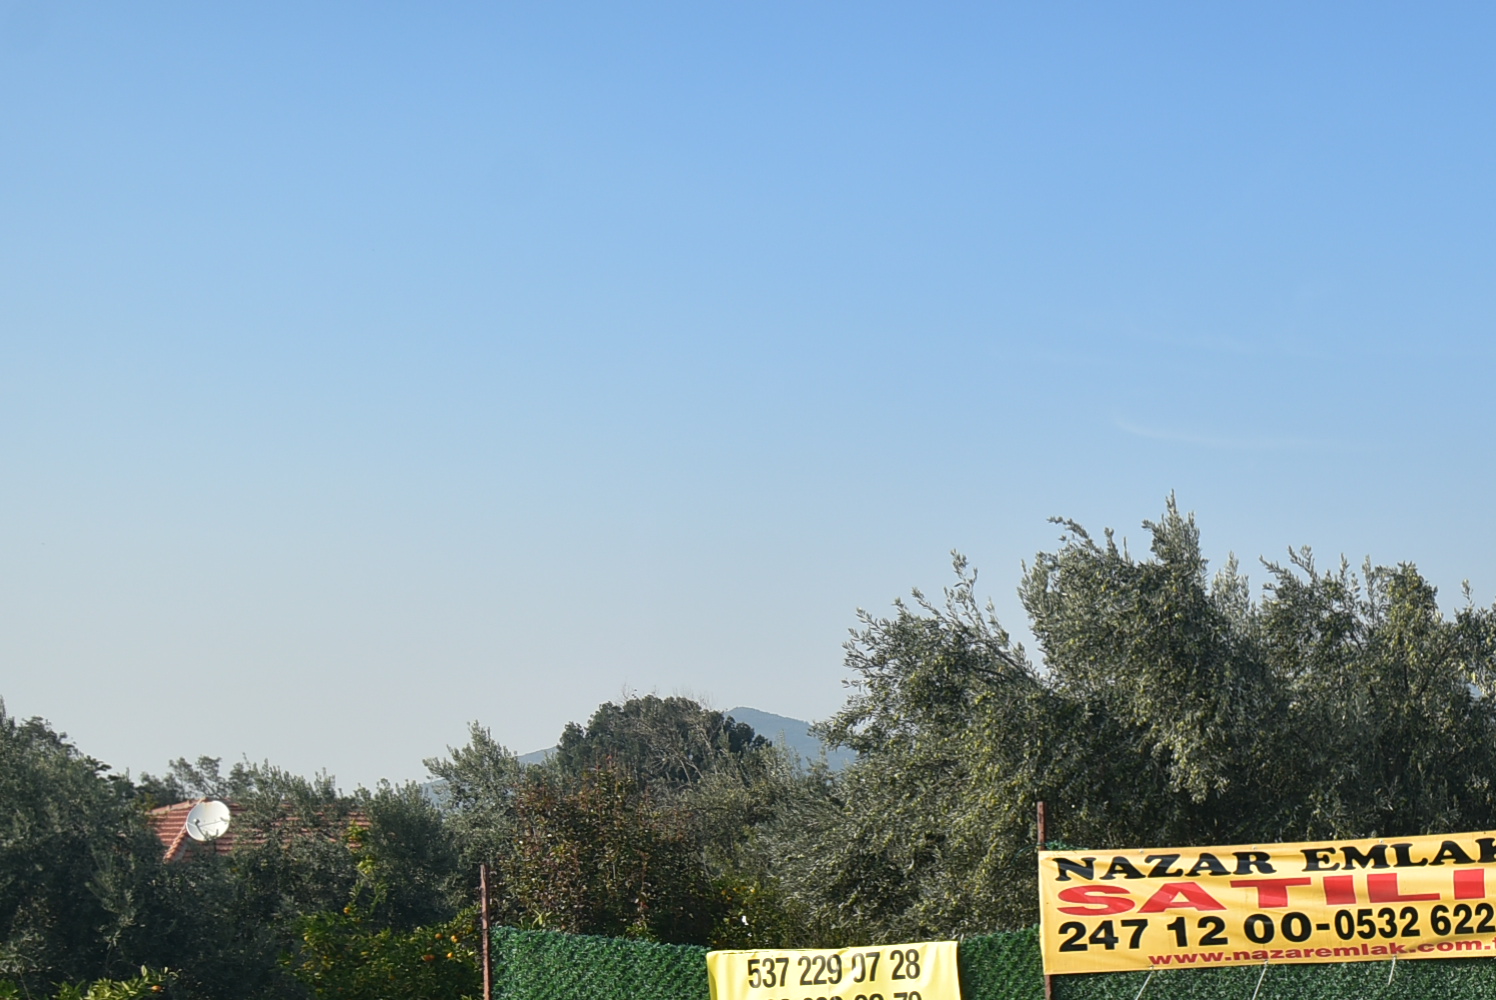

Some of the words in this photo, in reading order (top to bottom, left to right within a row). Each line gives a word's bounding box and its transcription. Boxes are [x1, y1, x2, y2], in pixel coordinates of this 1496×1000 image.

[1052, 851, 1277, 882] NAZAR
[1058, 918, 1149, 952] 247
[1167, 916, 1228, 947] 12
[1430, 903, 1496, 936] 622
[747, 957, 789, 988] 537
[798, 954, 842, 986] 229
[852, 952, 880, 983] 07
[890, 949, 920, 981] 28
